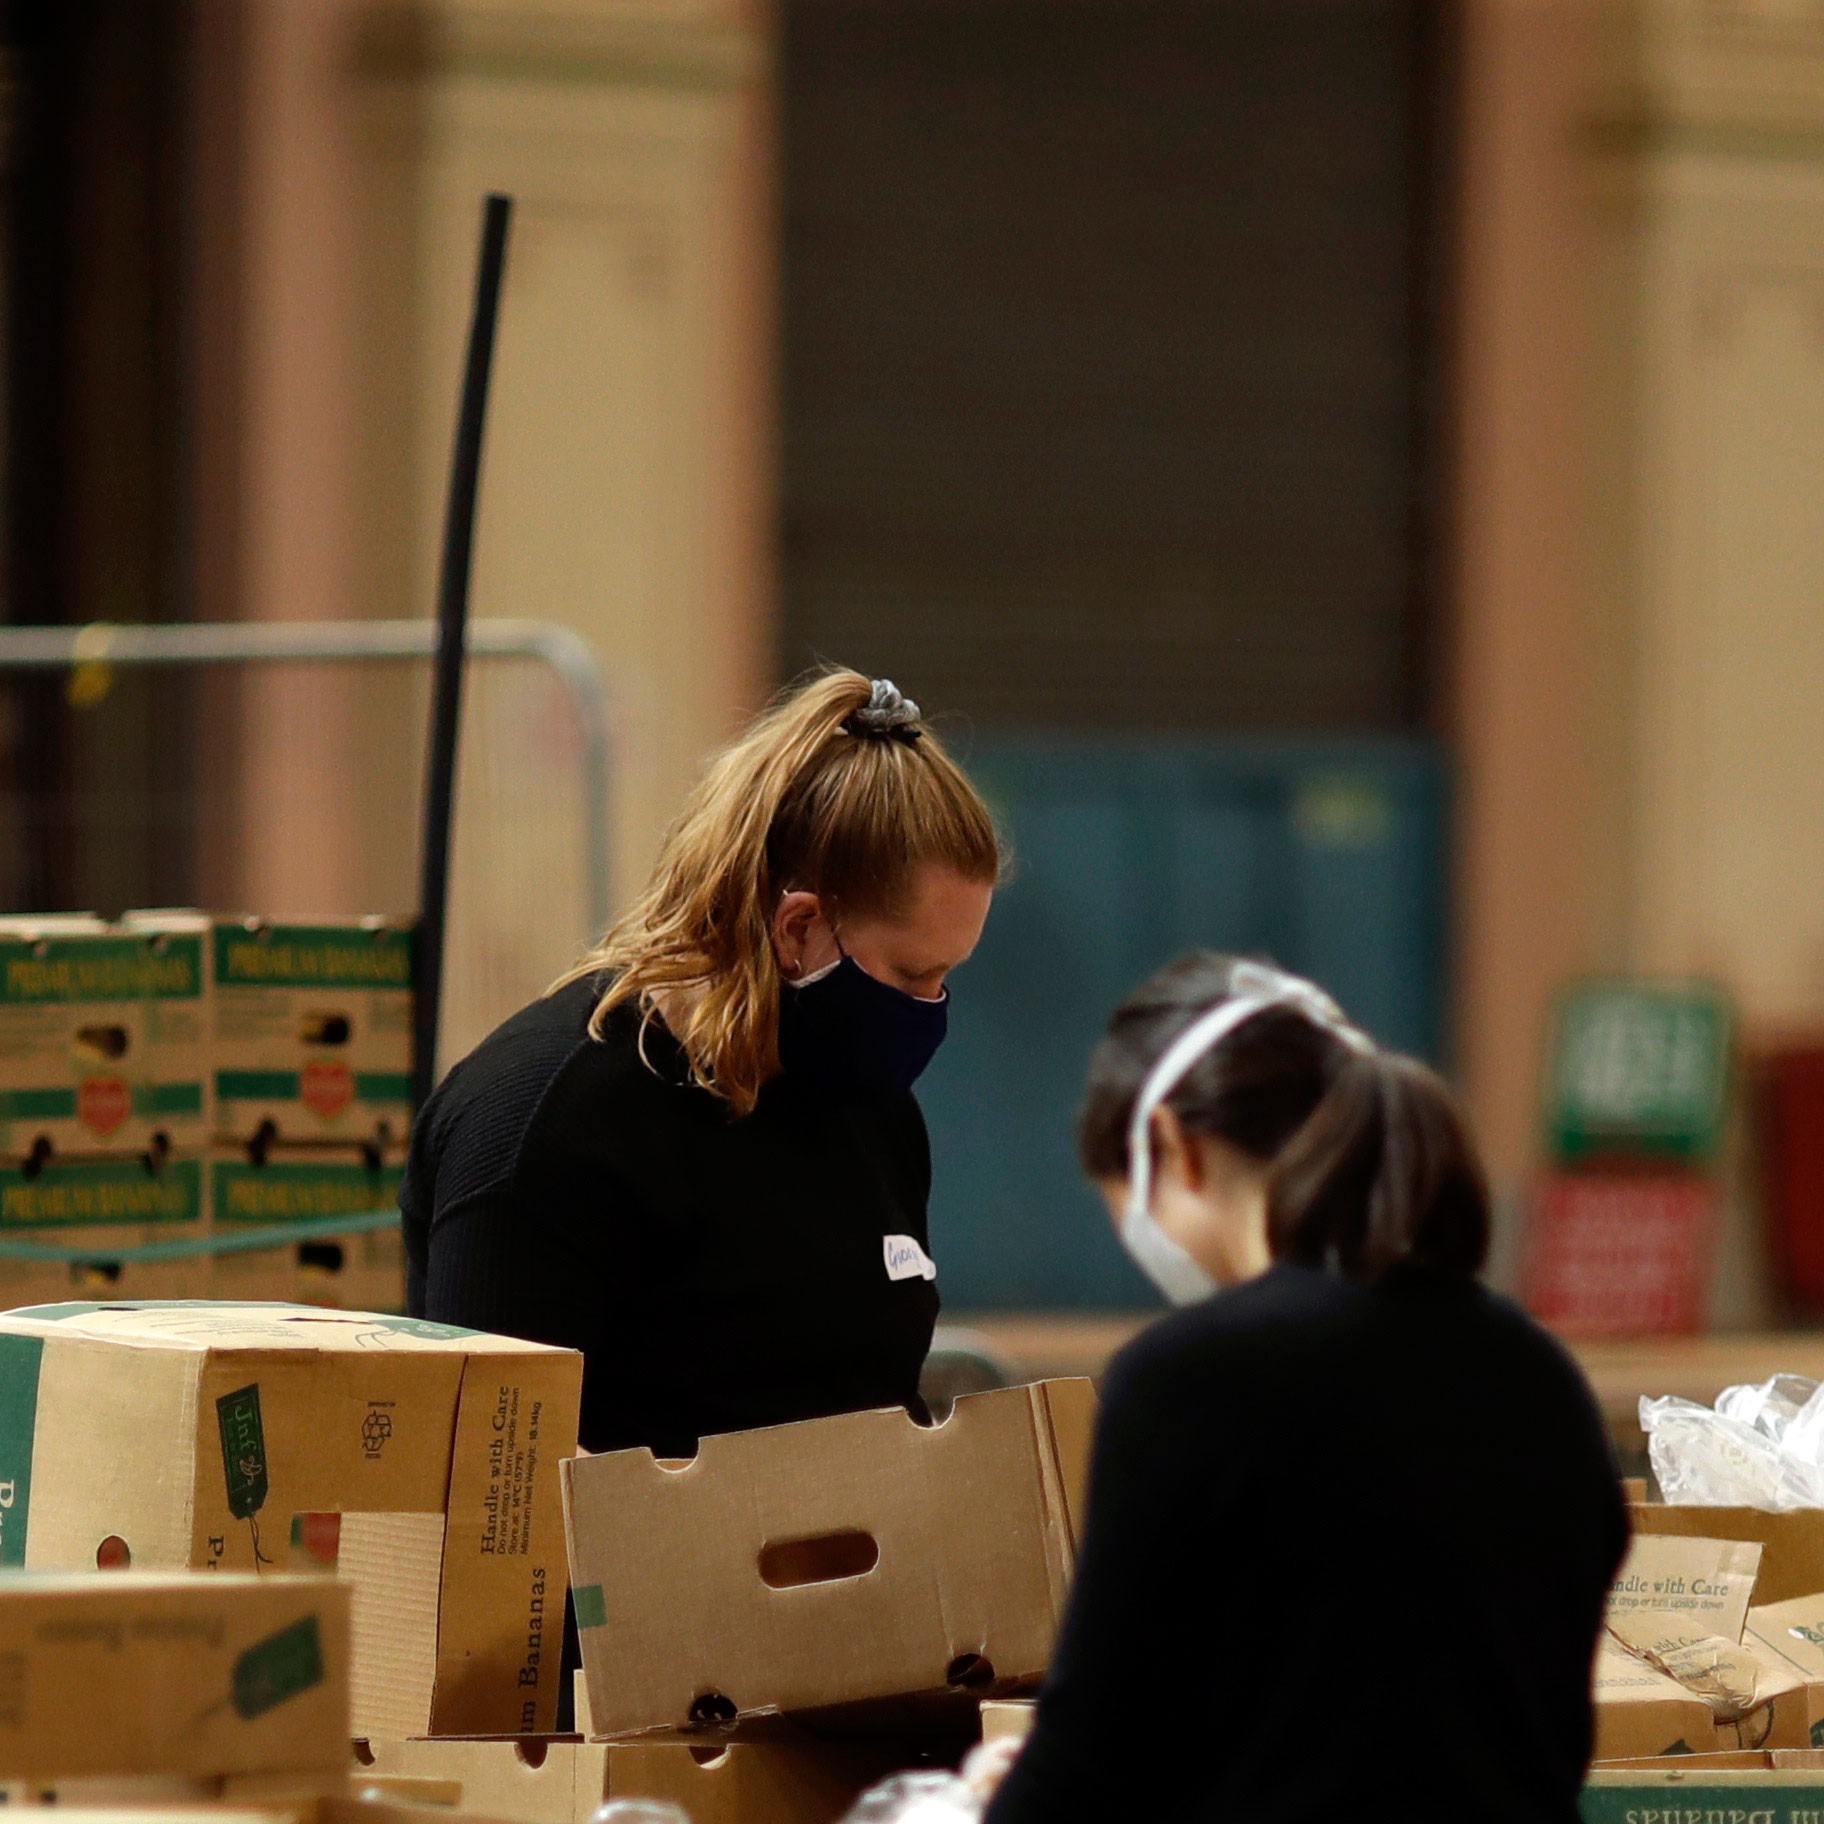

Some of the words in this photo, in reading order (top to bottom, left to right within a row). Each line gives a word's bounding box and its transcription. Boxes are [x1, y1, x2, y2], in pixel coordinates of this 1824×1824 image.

[491, 1386, 509, 1431] Care
[510, 1387, 520, 1416] down
[506, 1419, 517, 1453] upside
[489, 1438, 504, 1478] with
[503, 1455, 513, 1477] turn
[501, 1492, 511, 1517] drop
[523, 1486, 533, 1505] Net
[480, 1485, 498, 1555] Handle
[520, 1507, 531, 1555] Minimum
[1653, 1577, 1686, 1594] with
[1691, 1579, 1729, 1596] Care
[517, 1568, 546, 1689] Bananas
